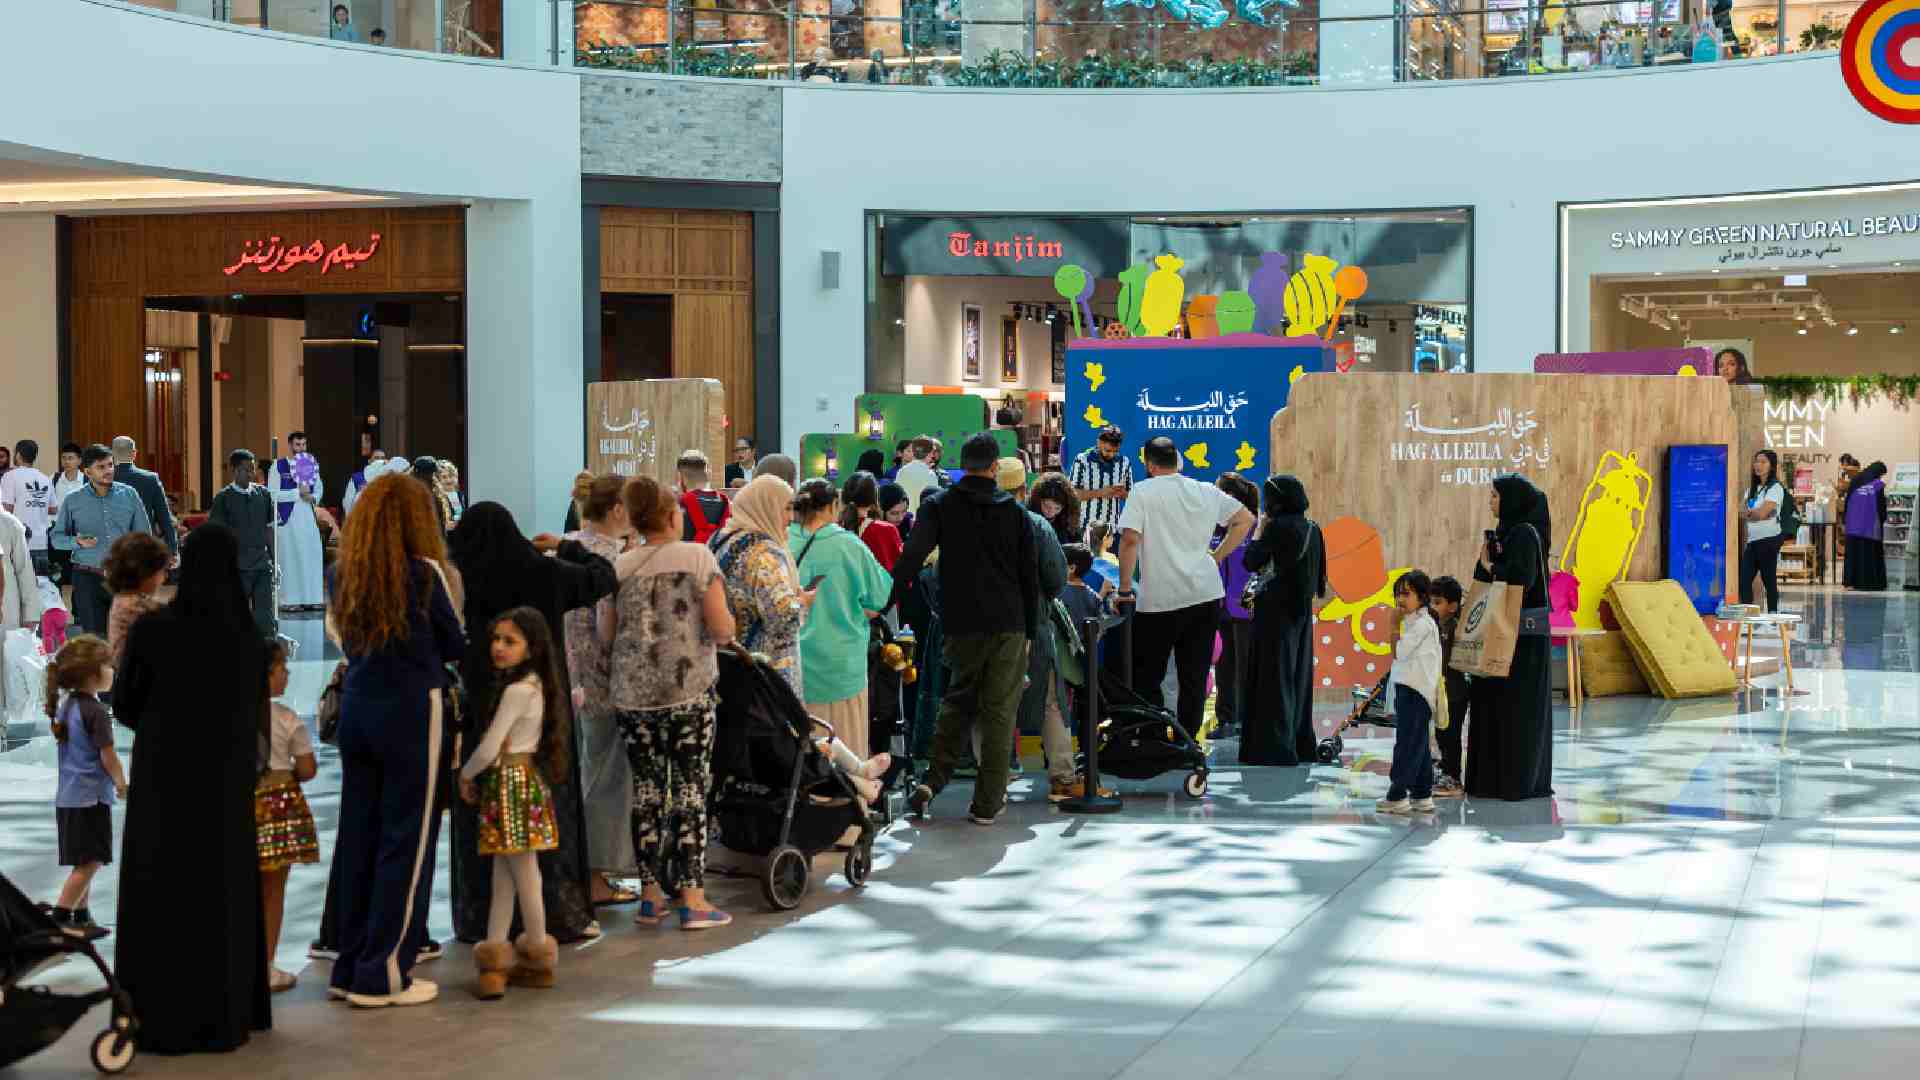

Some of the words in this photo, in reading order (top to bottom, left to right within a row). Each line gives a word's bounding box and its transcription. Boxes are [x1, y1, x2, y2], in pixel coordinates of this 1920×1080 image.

[946, 231, 1063, 263] Tanjim
[1611, 228, 1687, 249] SAMMY
[1688, 224, 1757, 245] GREEN
[1760, 219, 1858, 241] NATURAL
[1862, 213, 1920, 235] BEAU
[223, 236, 325, 275] هورتنز
[321, 231, 381, 275] تيم
[1147, 414, 1176, 429] HAG
[1177, 414, 1236, 429] ALLEILA
[1764, 399, 1833, 422] MMY
[1391, 442, 1426, 461] HAG
[1430, 442, 1503, 461] ALLEILA
